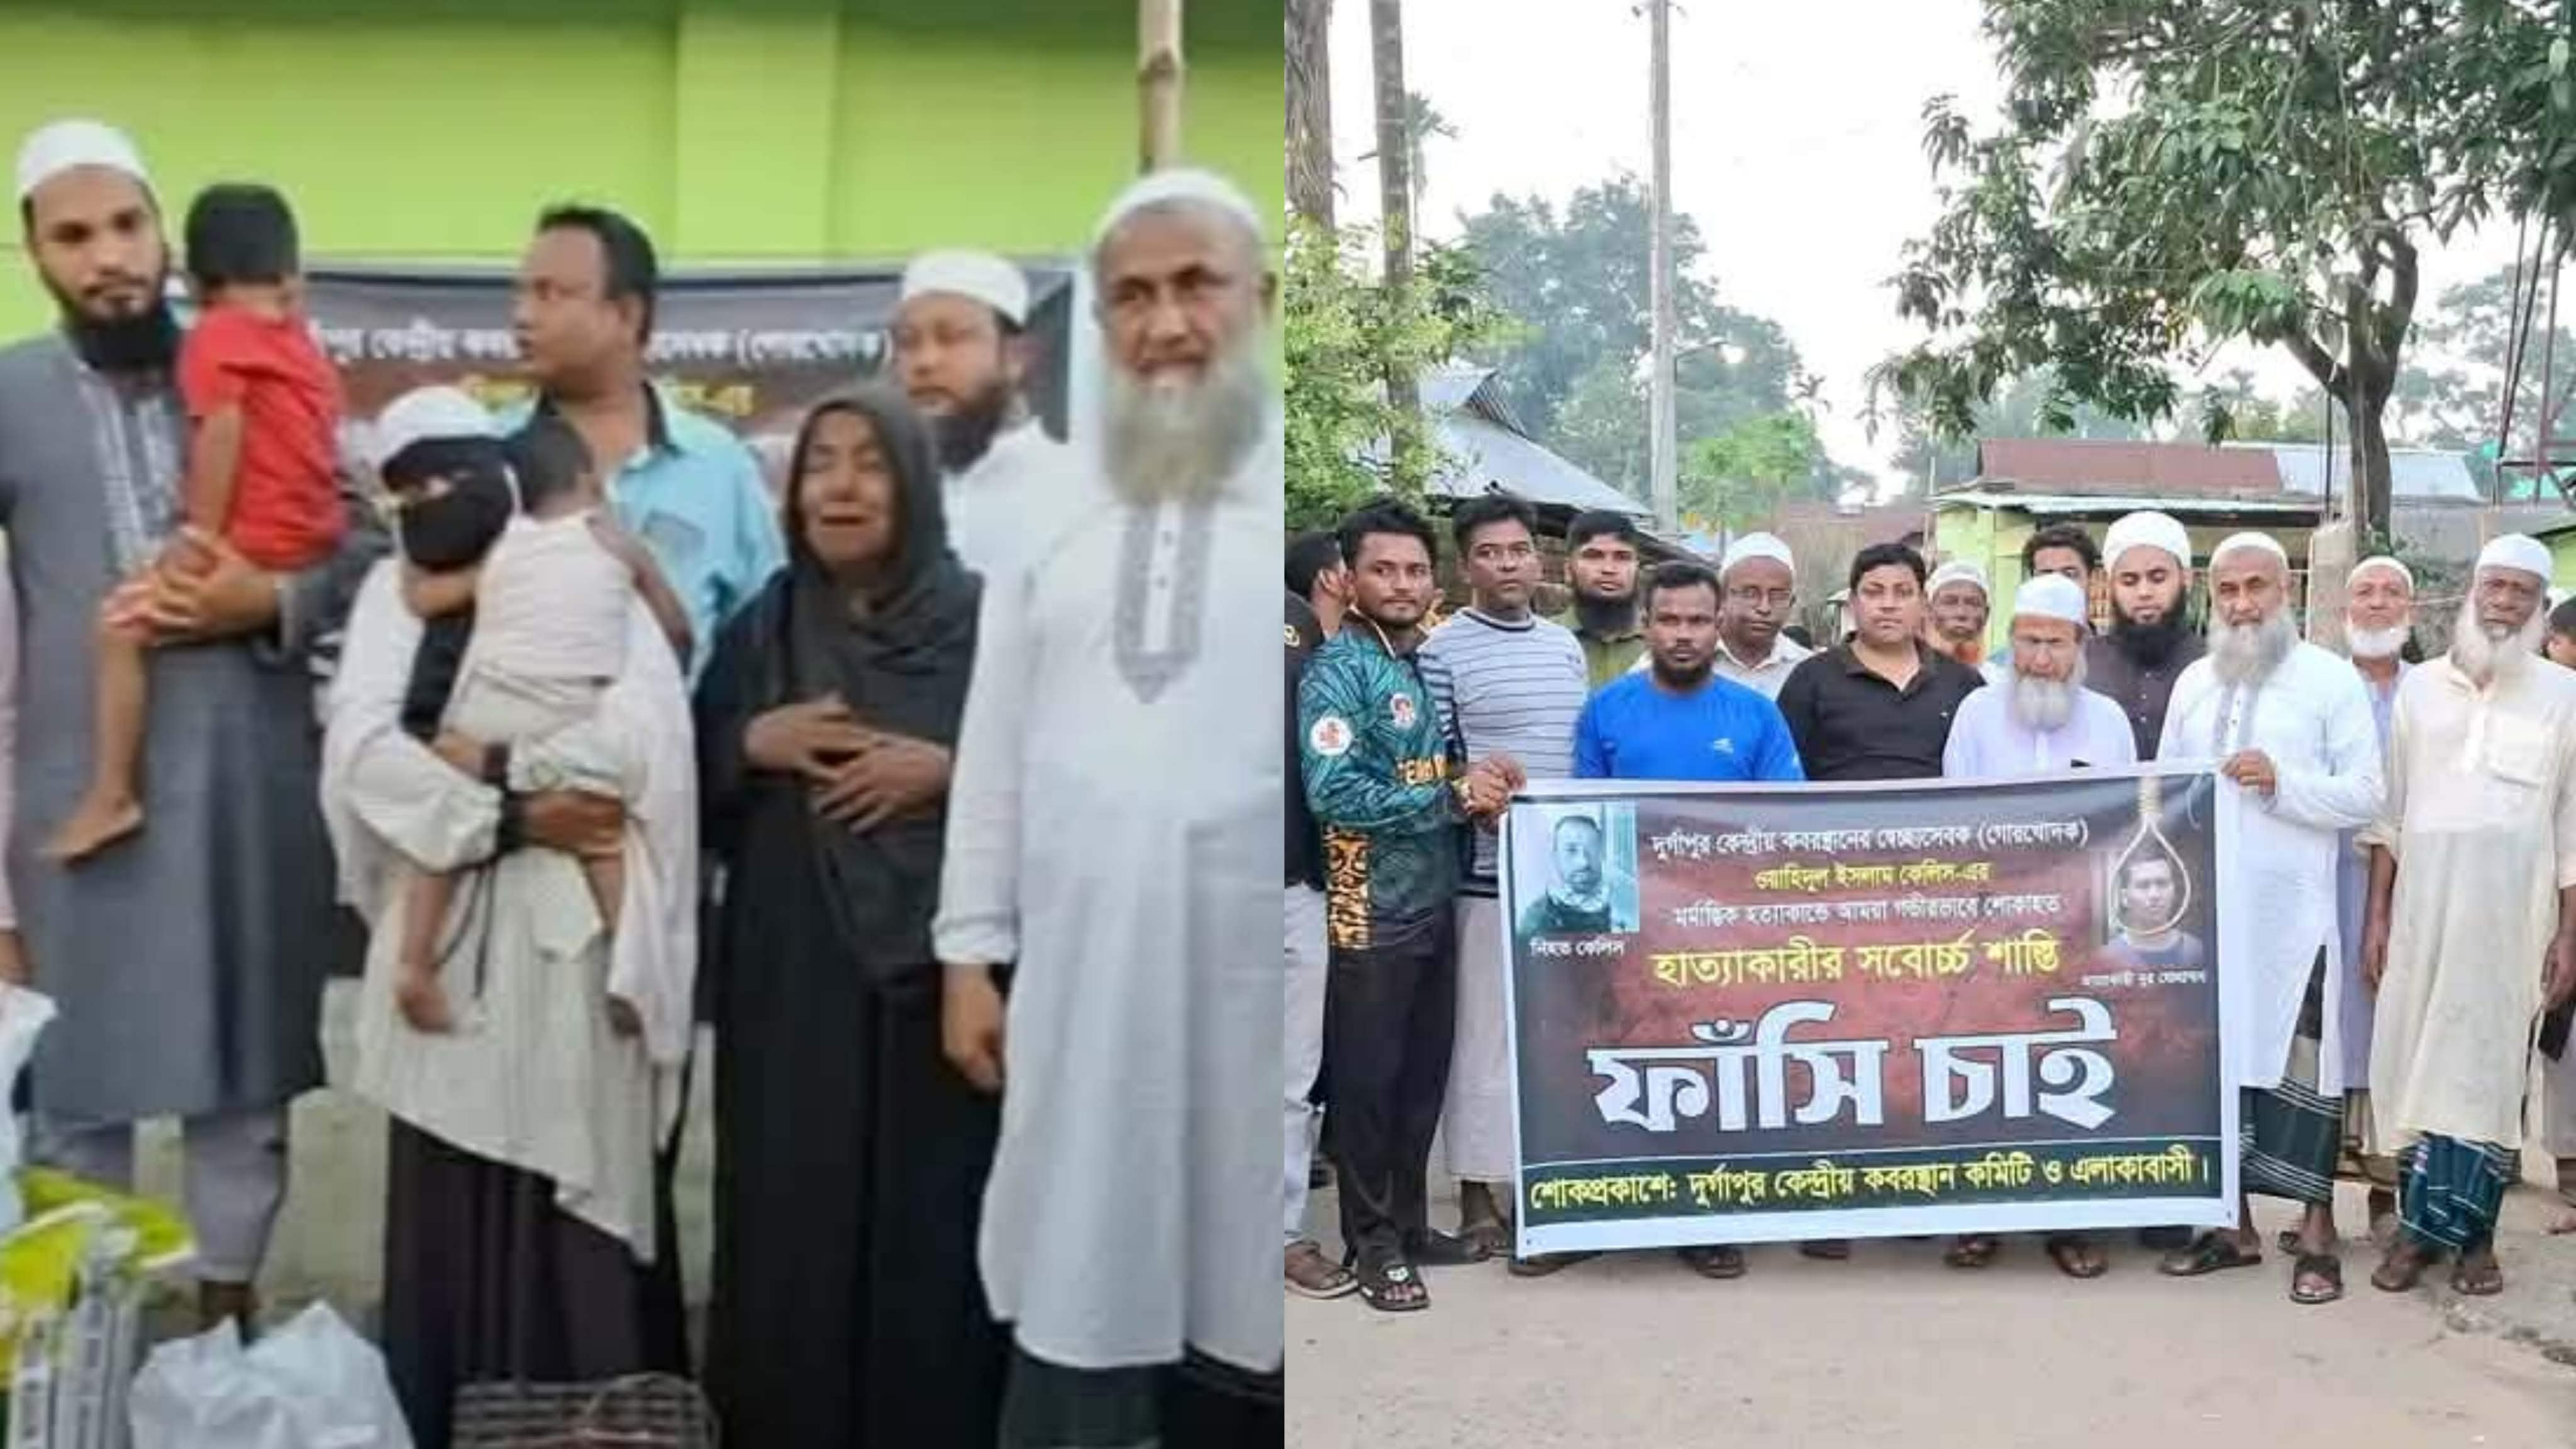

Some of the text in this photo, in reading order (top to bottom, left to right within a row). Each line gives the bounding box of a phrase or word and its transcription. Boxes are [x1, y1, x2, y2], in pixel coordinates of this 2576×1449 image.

[1651, 827, 1711, 860] দুর্গাপুর
[1716, 825, 1775, 855] কেন্দ্রীয়
[1780, 830, 1870, 853] কবরস্থানের
[1831, 861, 1896, 889] ইসলাম
[1982, 894, 2060, 916] শোকাহত
[1530, 936, 1571, 957] নিহত
[1585, 997, 2118, 1132] ফাঁসি চাই
[1686, 1163, 1767, 1208] দুর্গাপুর
[1774, 1158, 1855, 1199] কেন্দ্রীয়
[1860, 1165, 1954, 1198] কবরস্থান
[1960, 1151, 2033, 1189] কমিটি
[2041, 1162, 2062, 1185] ও
